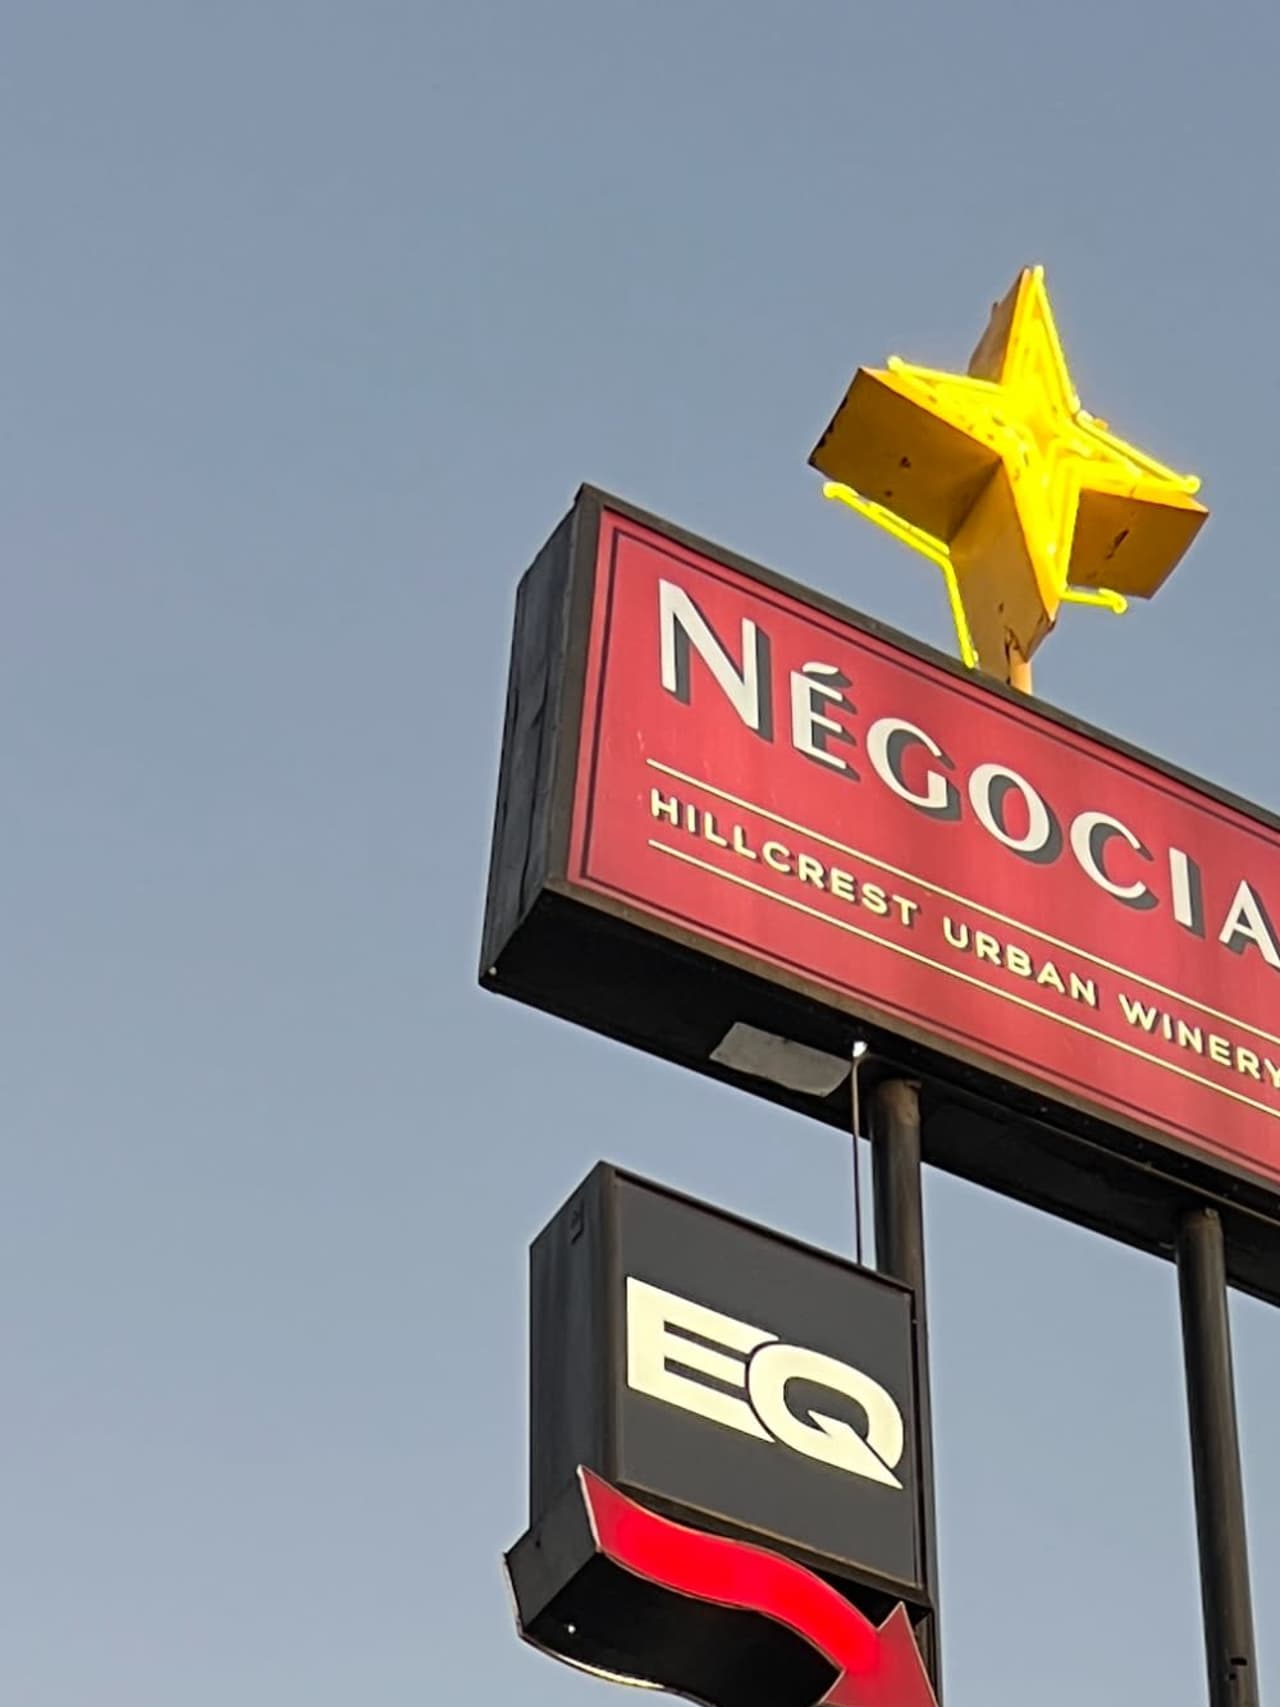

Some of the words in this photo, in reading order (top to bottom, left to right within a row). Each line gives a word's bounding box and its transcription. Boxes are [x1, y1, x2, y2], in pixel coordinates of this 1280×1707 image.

[651, 788, 919, 926] HILLCREST
[942, 916, 1098, 1008] URBAN
[626, 1275, 904, 1489] EQ
